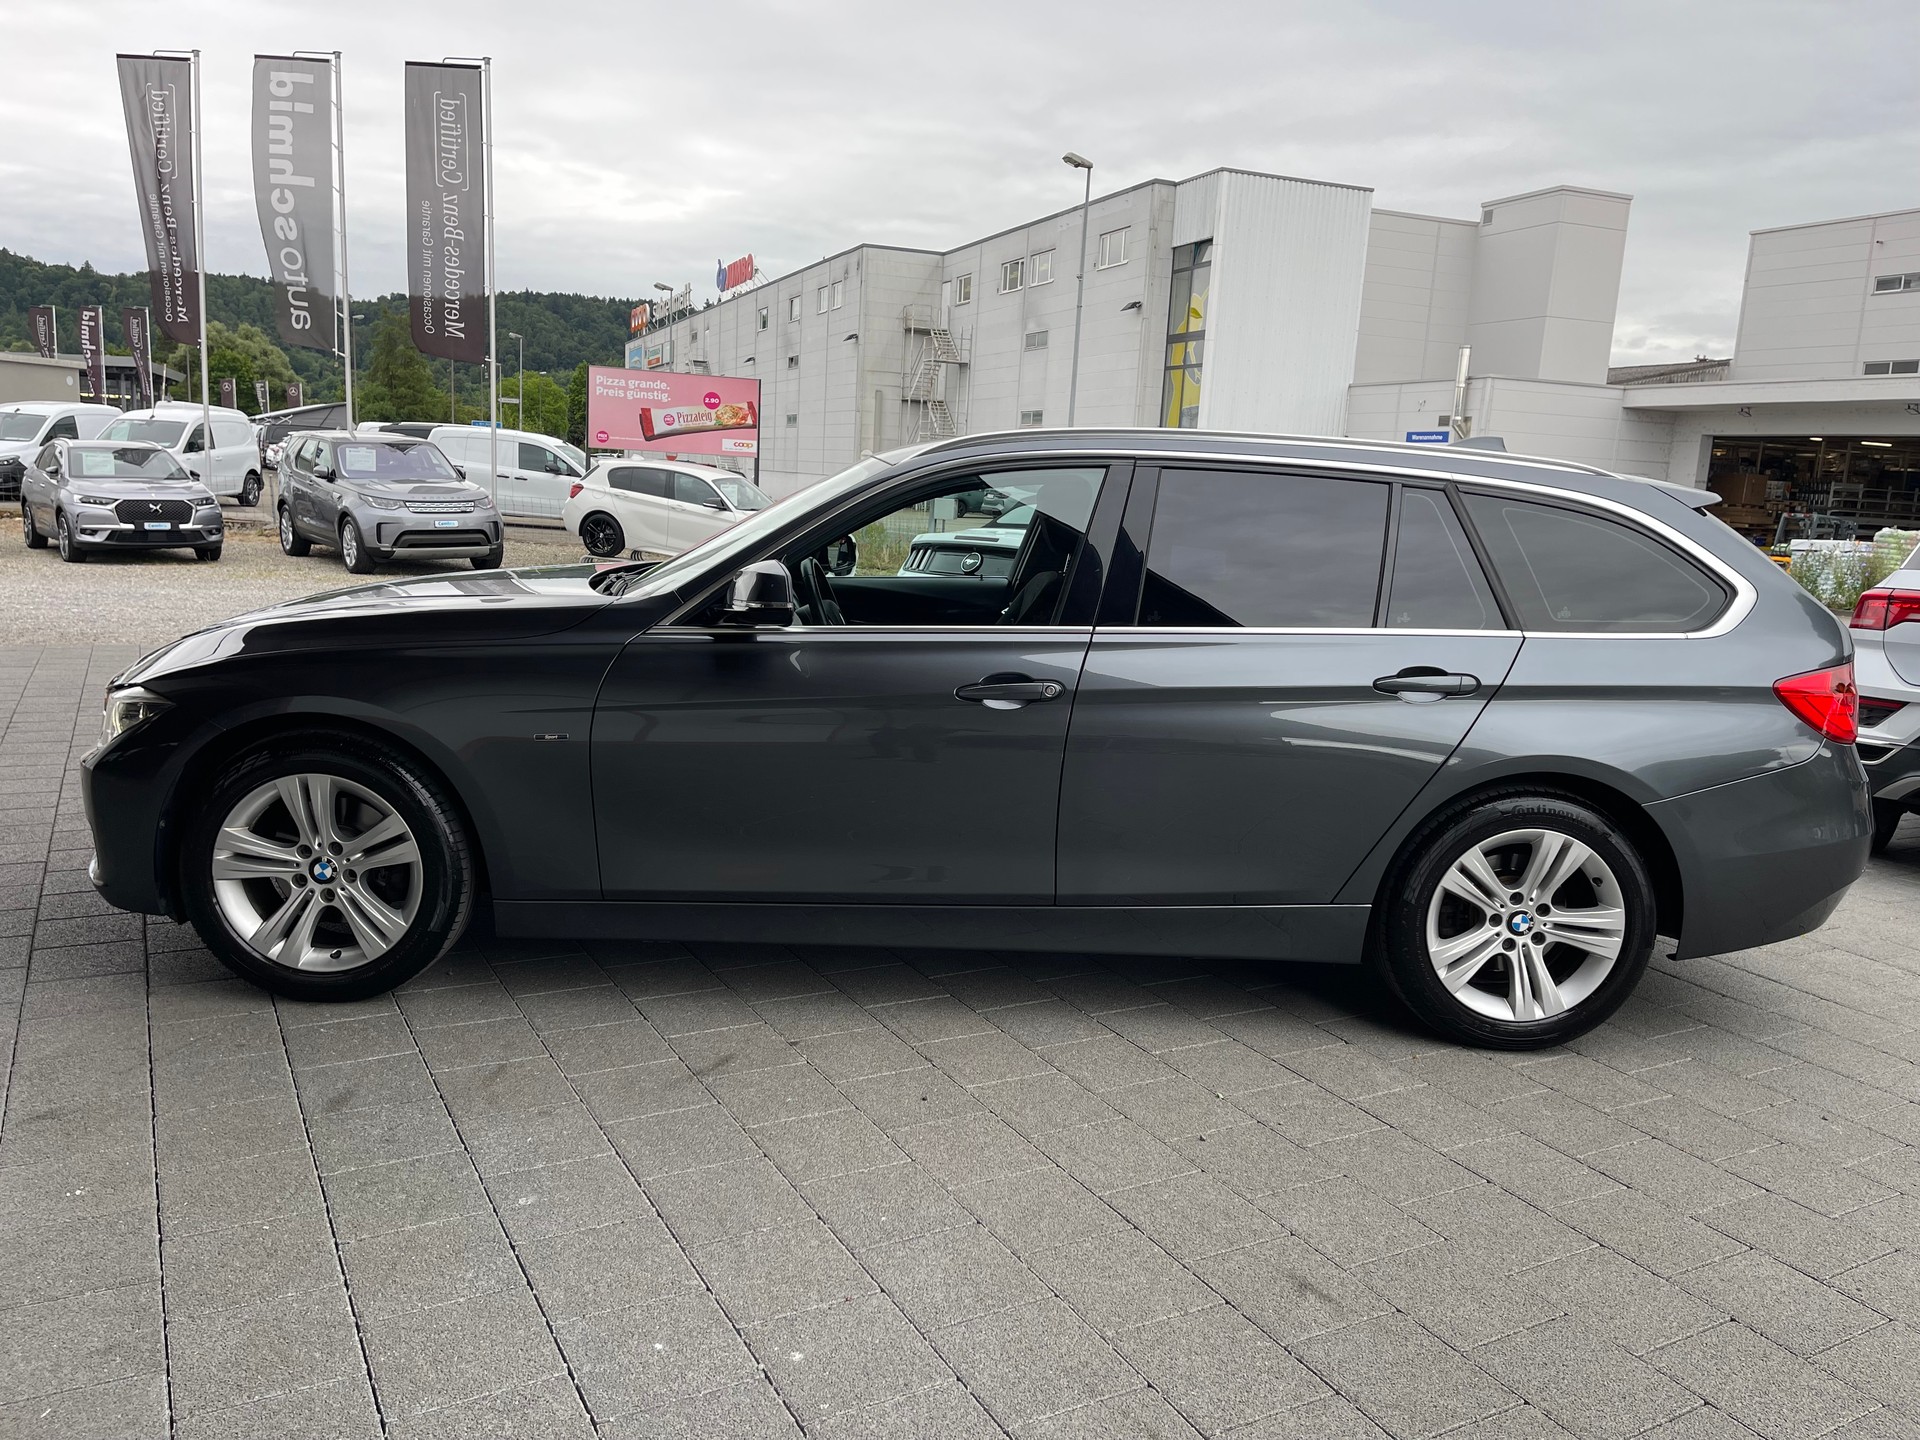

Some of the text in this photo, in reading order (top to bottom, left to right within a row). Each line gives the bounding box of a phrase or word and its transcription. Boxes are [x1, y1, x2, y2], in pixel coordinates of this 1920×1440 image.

[596, 375, 670, 391] Pizza grande.
[596, 386, 671, 403] Preis günstig.
[676, 409, 713, 424] Pizzateig
